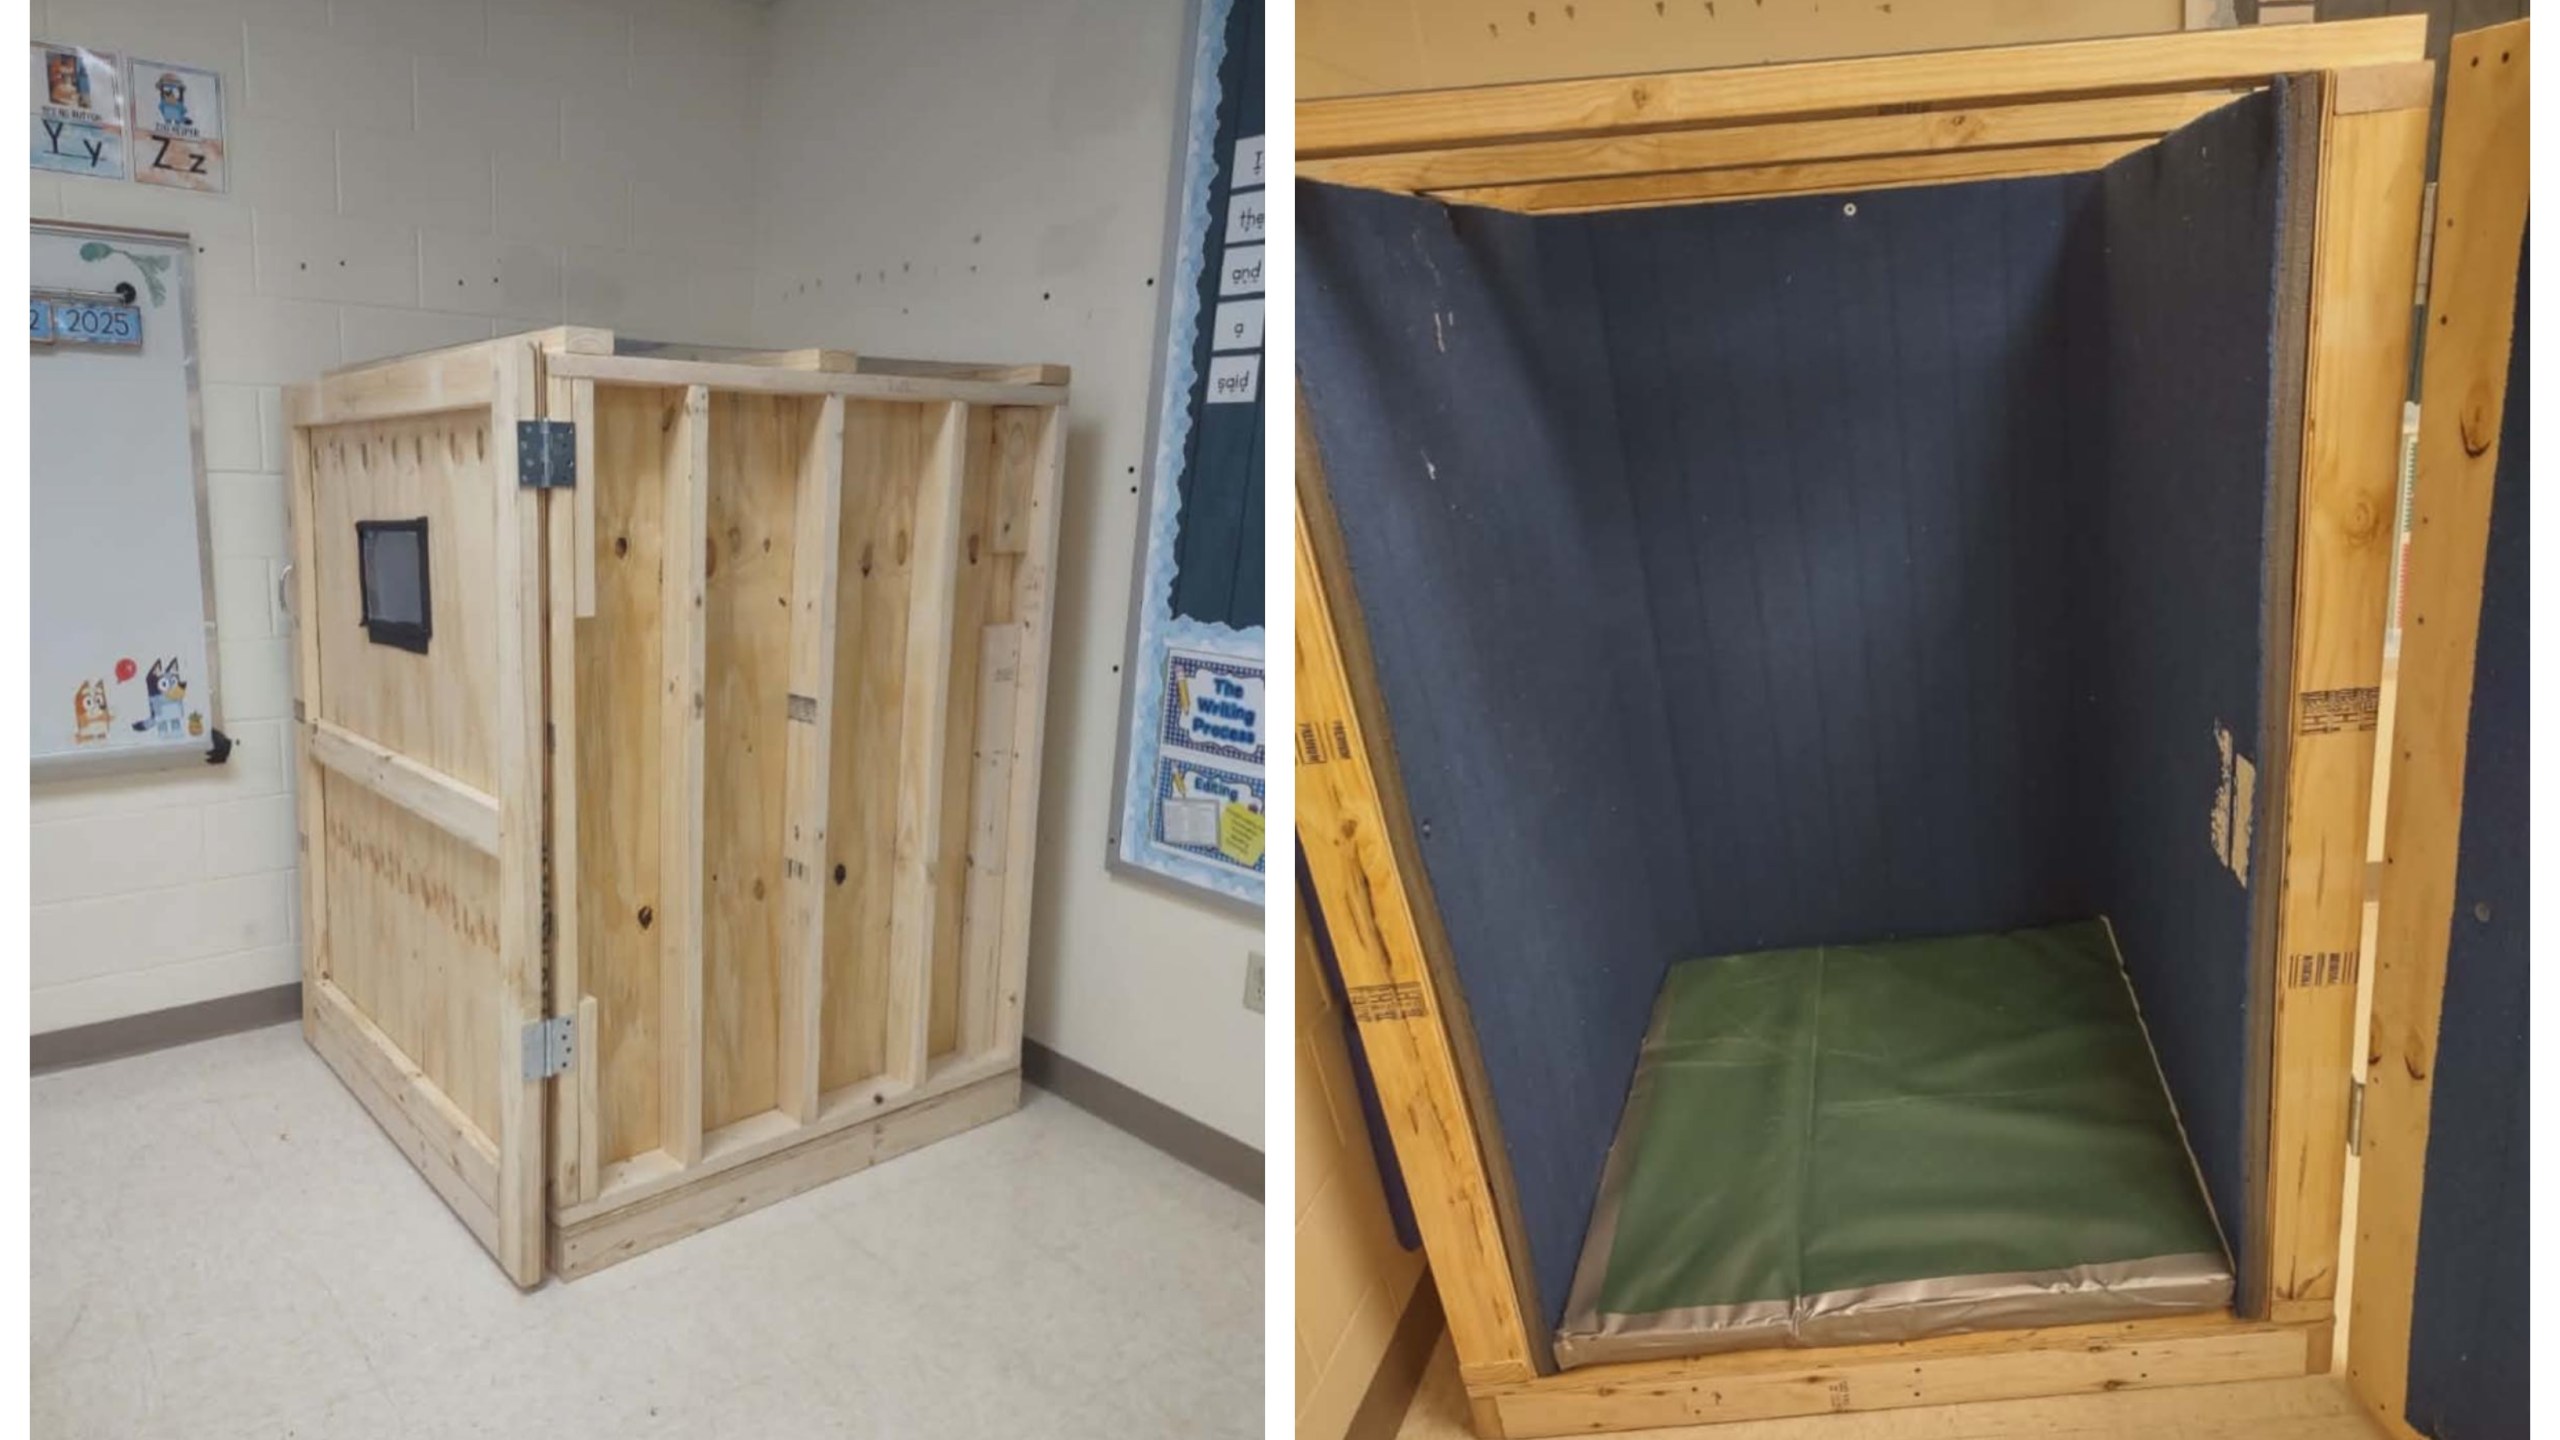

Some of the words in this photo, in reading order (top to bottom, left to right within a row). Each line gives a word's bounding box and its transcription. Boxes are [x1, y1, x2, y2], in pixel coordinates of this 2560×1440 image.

[42, 119, 63, 154] Y
[83, 138, 102, 168] y
[152, 134, 173, 170] Z
[189, 153, 207, 174] z
[1253, 150, 1263, 171] I
[1240, 207, 1264, 227] the
[1232, 259, 1262, 281] and
[65, 309, 129, 336] 2025
[1234, 322, 1244, 335] a
[1217, 371, 1250, 391] said
[1214, 678, 1244, 698] The
[1197, 698, 1255, 727] Writing
[1193, 718, 1255, 744] Process
[1195, 778, 1238, 802] Editing
